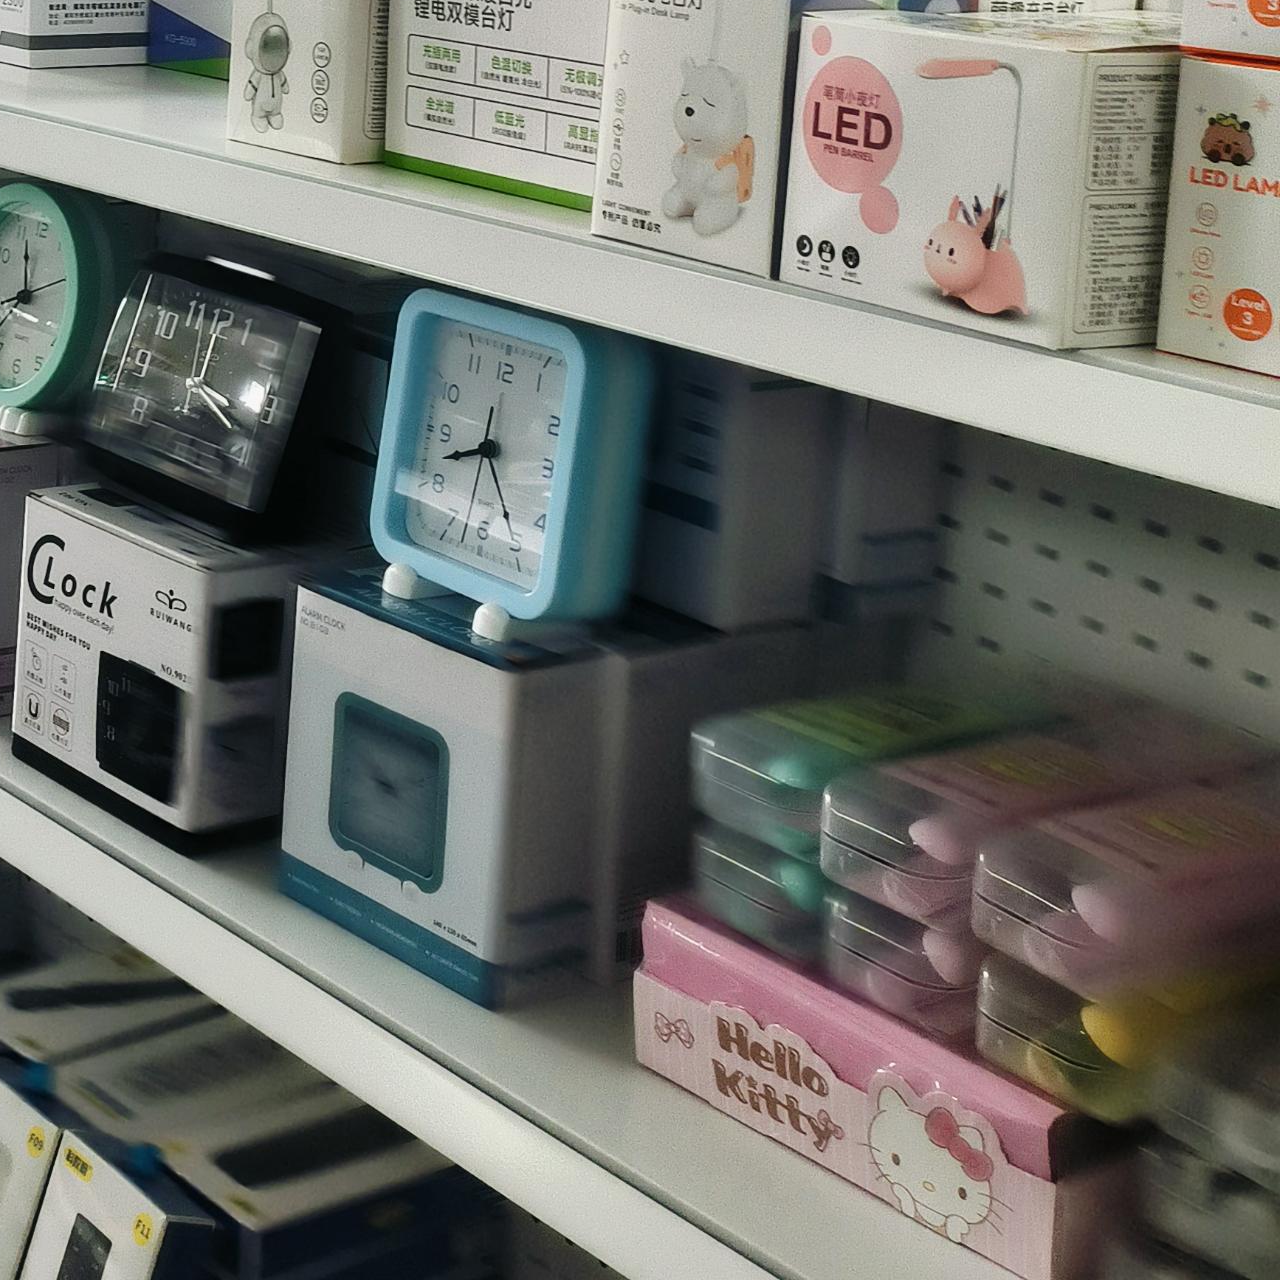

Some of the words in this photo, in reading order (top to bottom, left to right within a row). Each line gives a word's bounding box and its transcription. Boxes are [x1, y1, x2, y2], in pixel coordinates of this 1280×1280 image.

[812, 101, 892, 150] LED
[1189, 166, 1228, 188] LED
[26, 611, 41, 624] BEST
[43, 618, 64, 636] WISHES
[66, 631, 77, 643] FOR
[78, 637, 91, 650] YOU
[26, 621, 44, 636] HAPPY
[46, 631, 57, 641] DAY
[715, 1016, 830, 1098] Hello
[712, 1059, 837, 1152] Kitty
[28, 1133, 44, 1151] F09
[135, 1219, 151, 1240] F11
